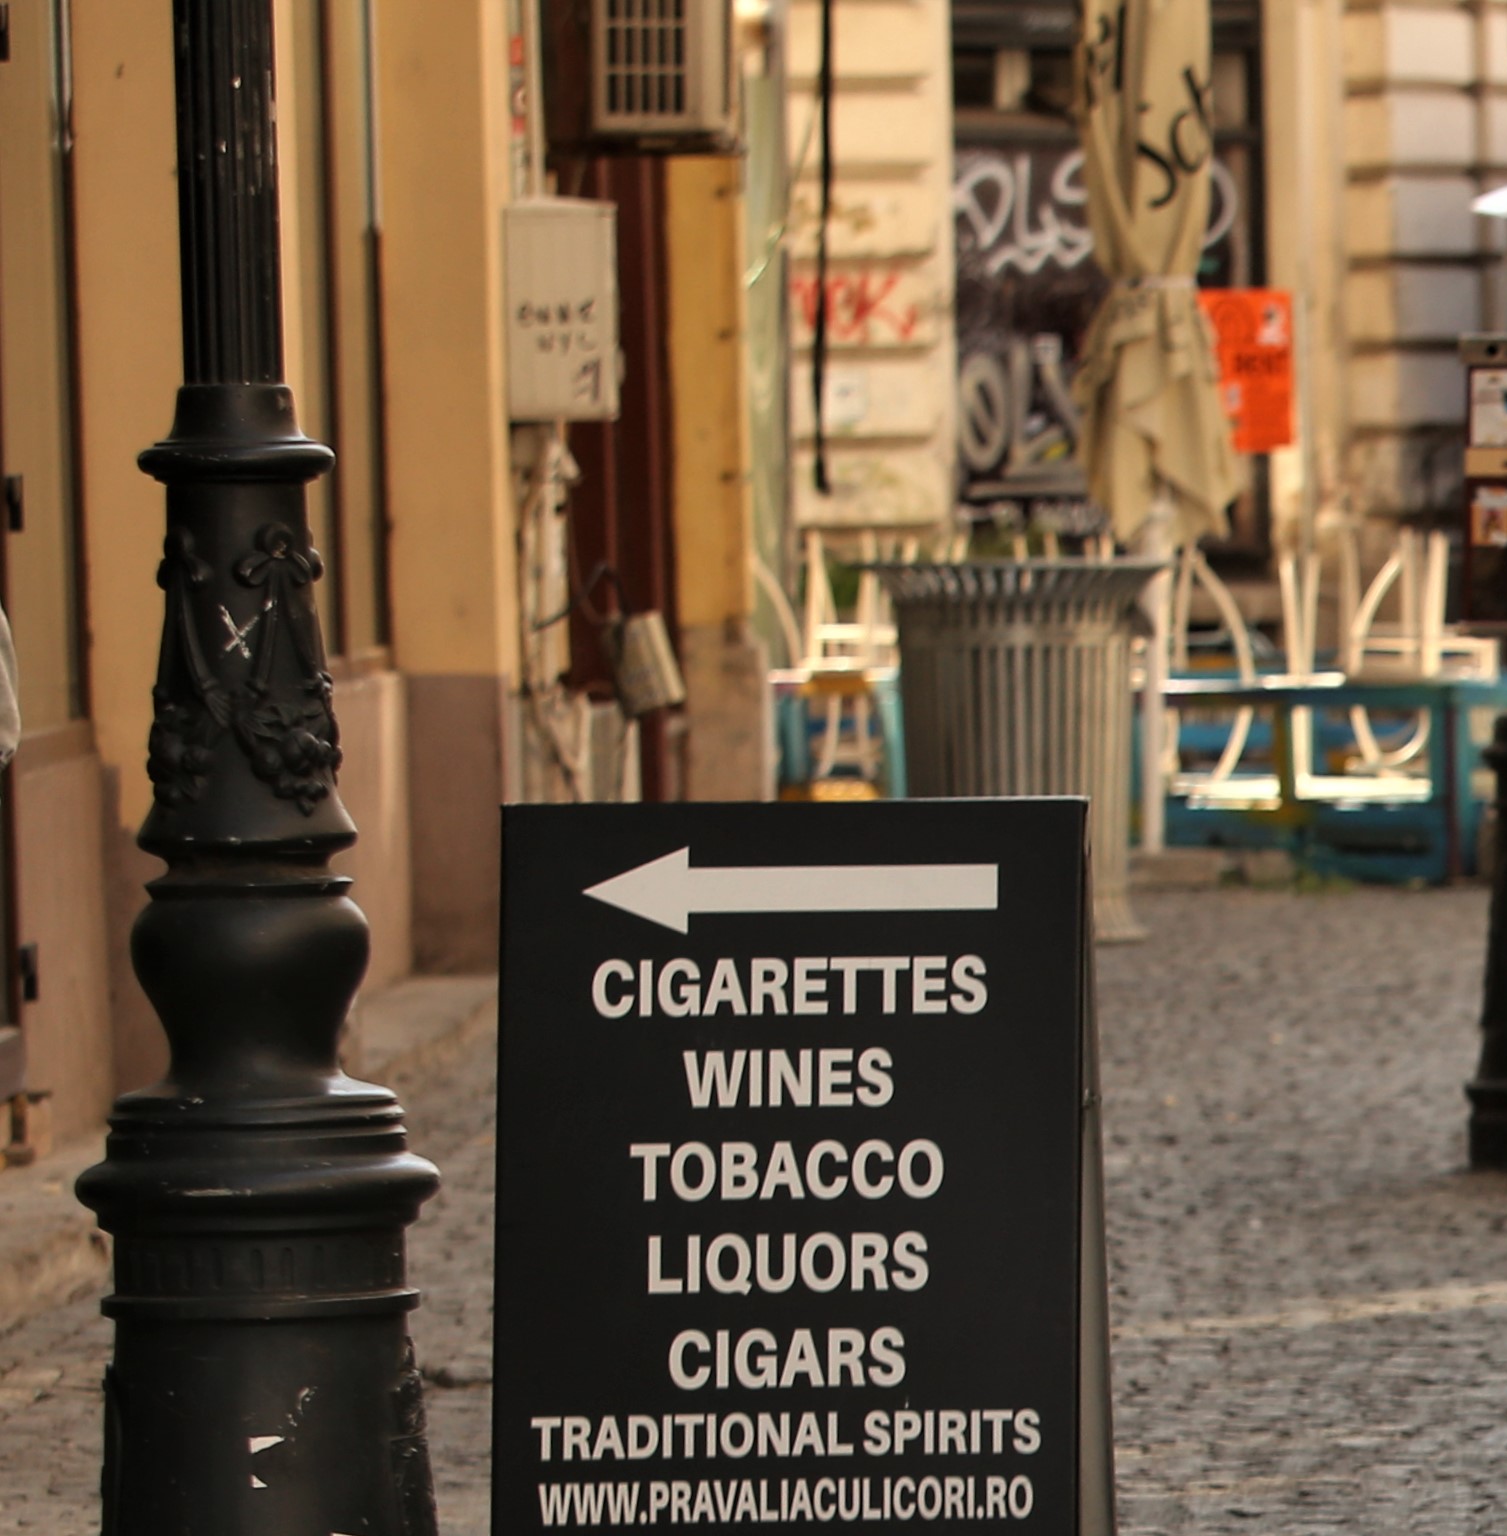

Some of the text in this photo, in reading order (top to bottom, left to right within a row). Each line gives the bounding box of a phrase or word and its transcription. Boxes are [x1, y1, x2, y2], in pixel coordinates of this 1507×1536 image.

[592, 955, 988, 1018] CIGARETTES
[683, 1047, 894, 1108] WINES
[630, 1138, 944, 1201] TOBACCO
[647, 1230, 929, 1296] LIQUORS
[669, 1327, 906, 1390] CIGARS
[531, 1408, 1042, 1461] TRADITIONAL SPIRITS
[539, 1475, 1034, 1526] WWW.PRAVALIACULICORI.RO
